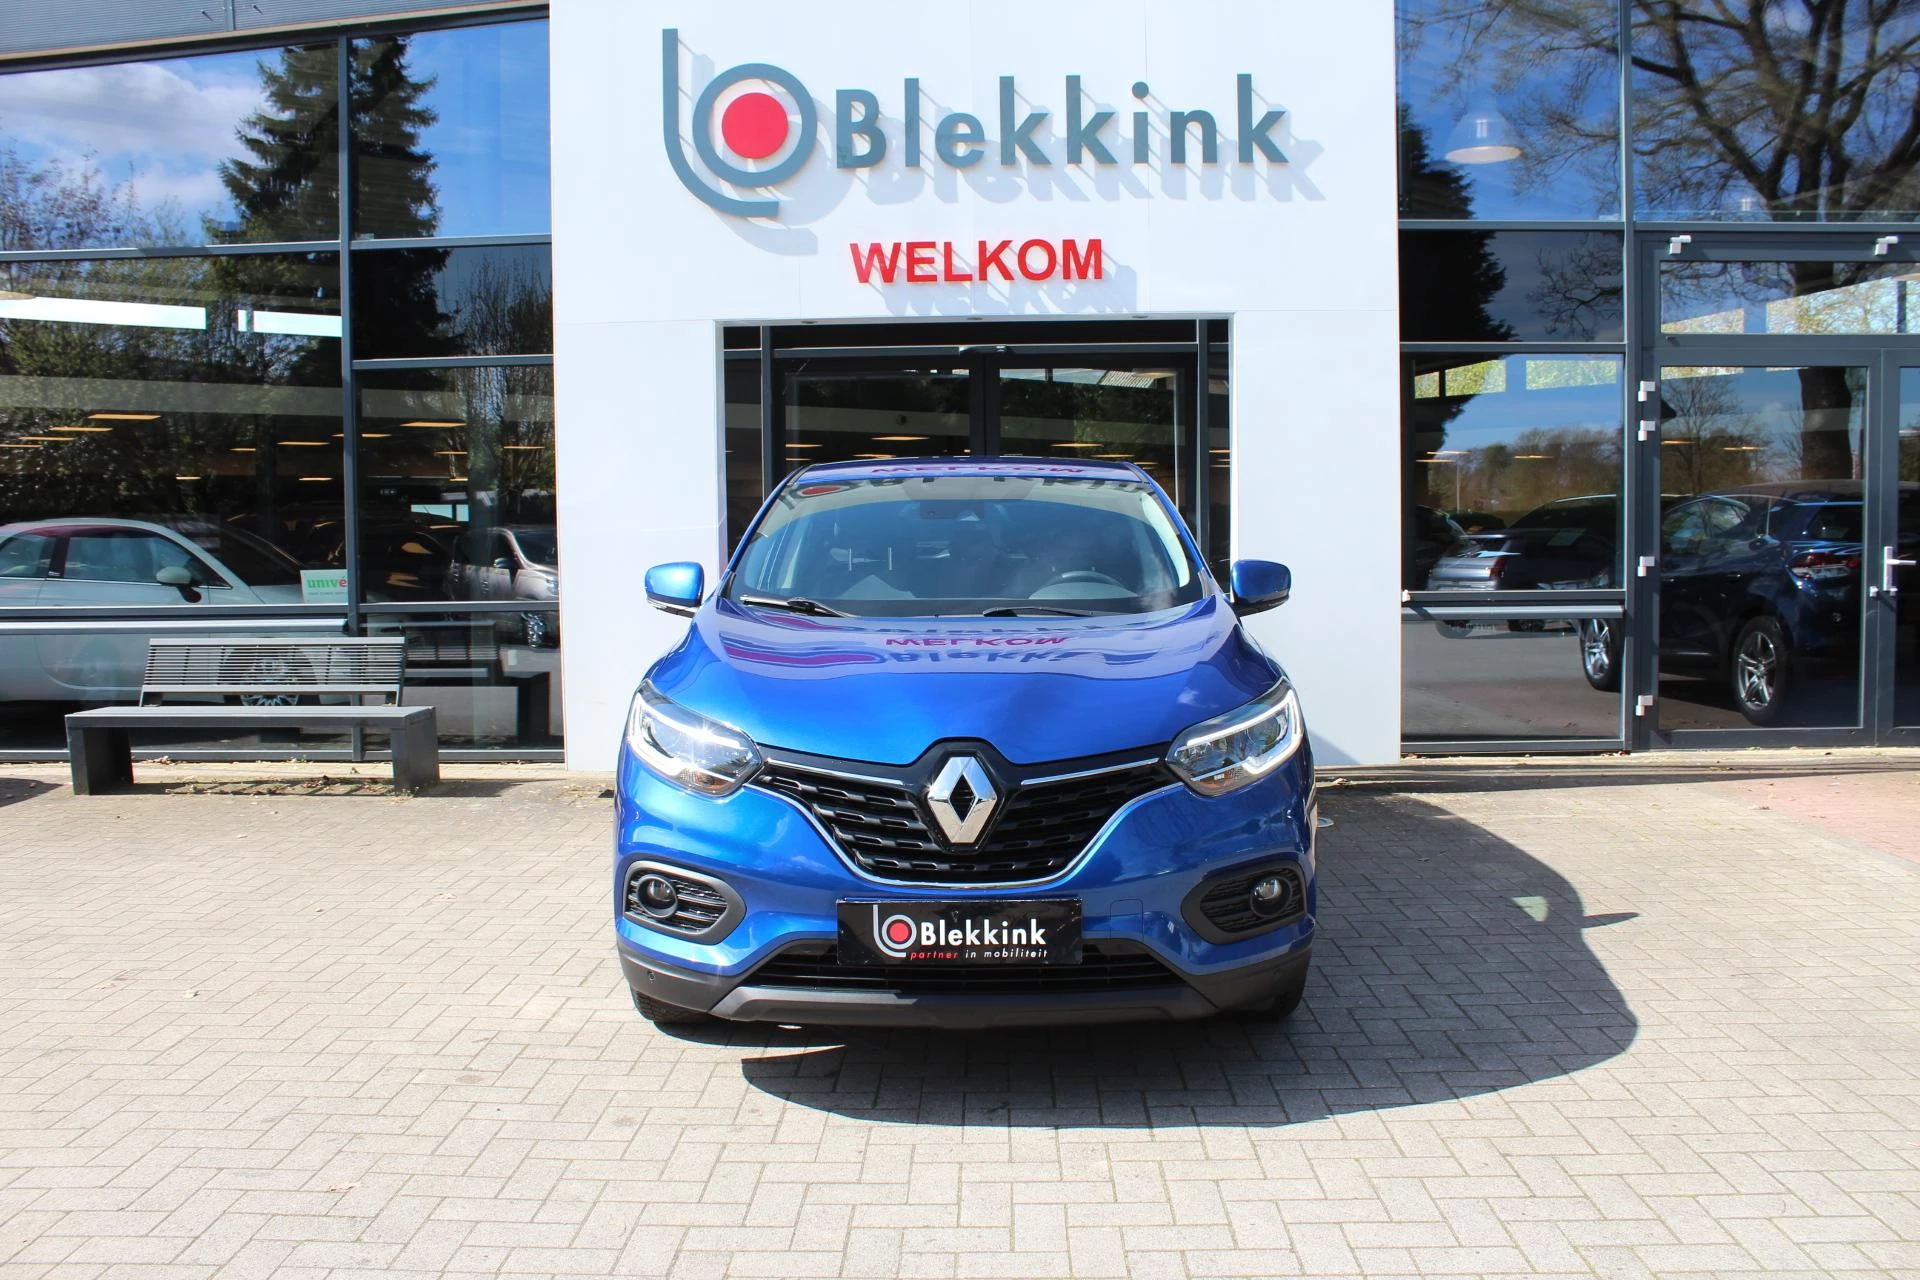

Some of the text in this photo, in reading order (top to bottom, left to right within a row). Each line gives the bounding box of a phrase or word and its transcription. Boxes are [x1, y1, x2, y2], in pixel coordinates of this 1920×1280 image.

[836, 73, 1289, 169] Blekkink
[850, 238, 1103, 284] WELKOM
[920, 918, 1046, 946] Blekkink
[910, 947, 1048, 960] partner in mobiliteit
